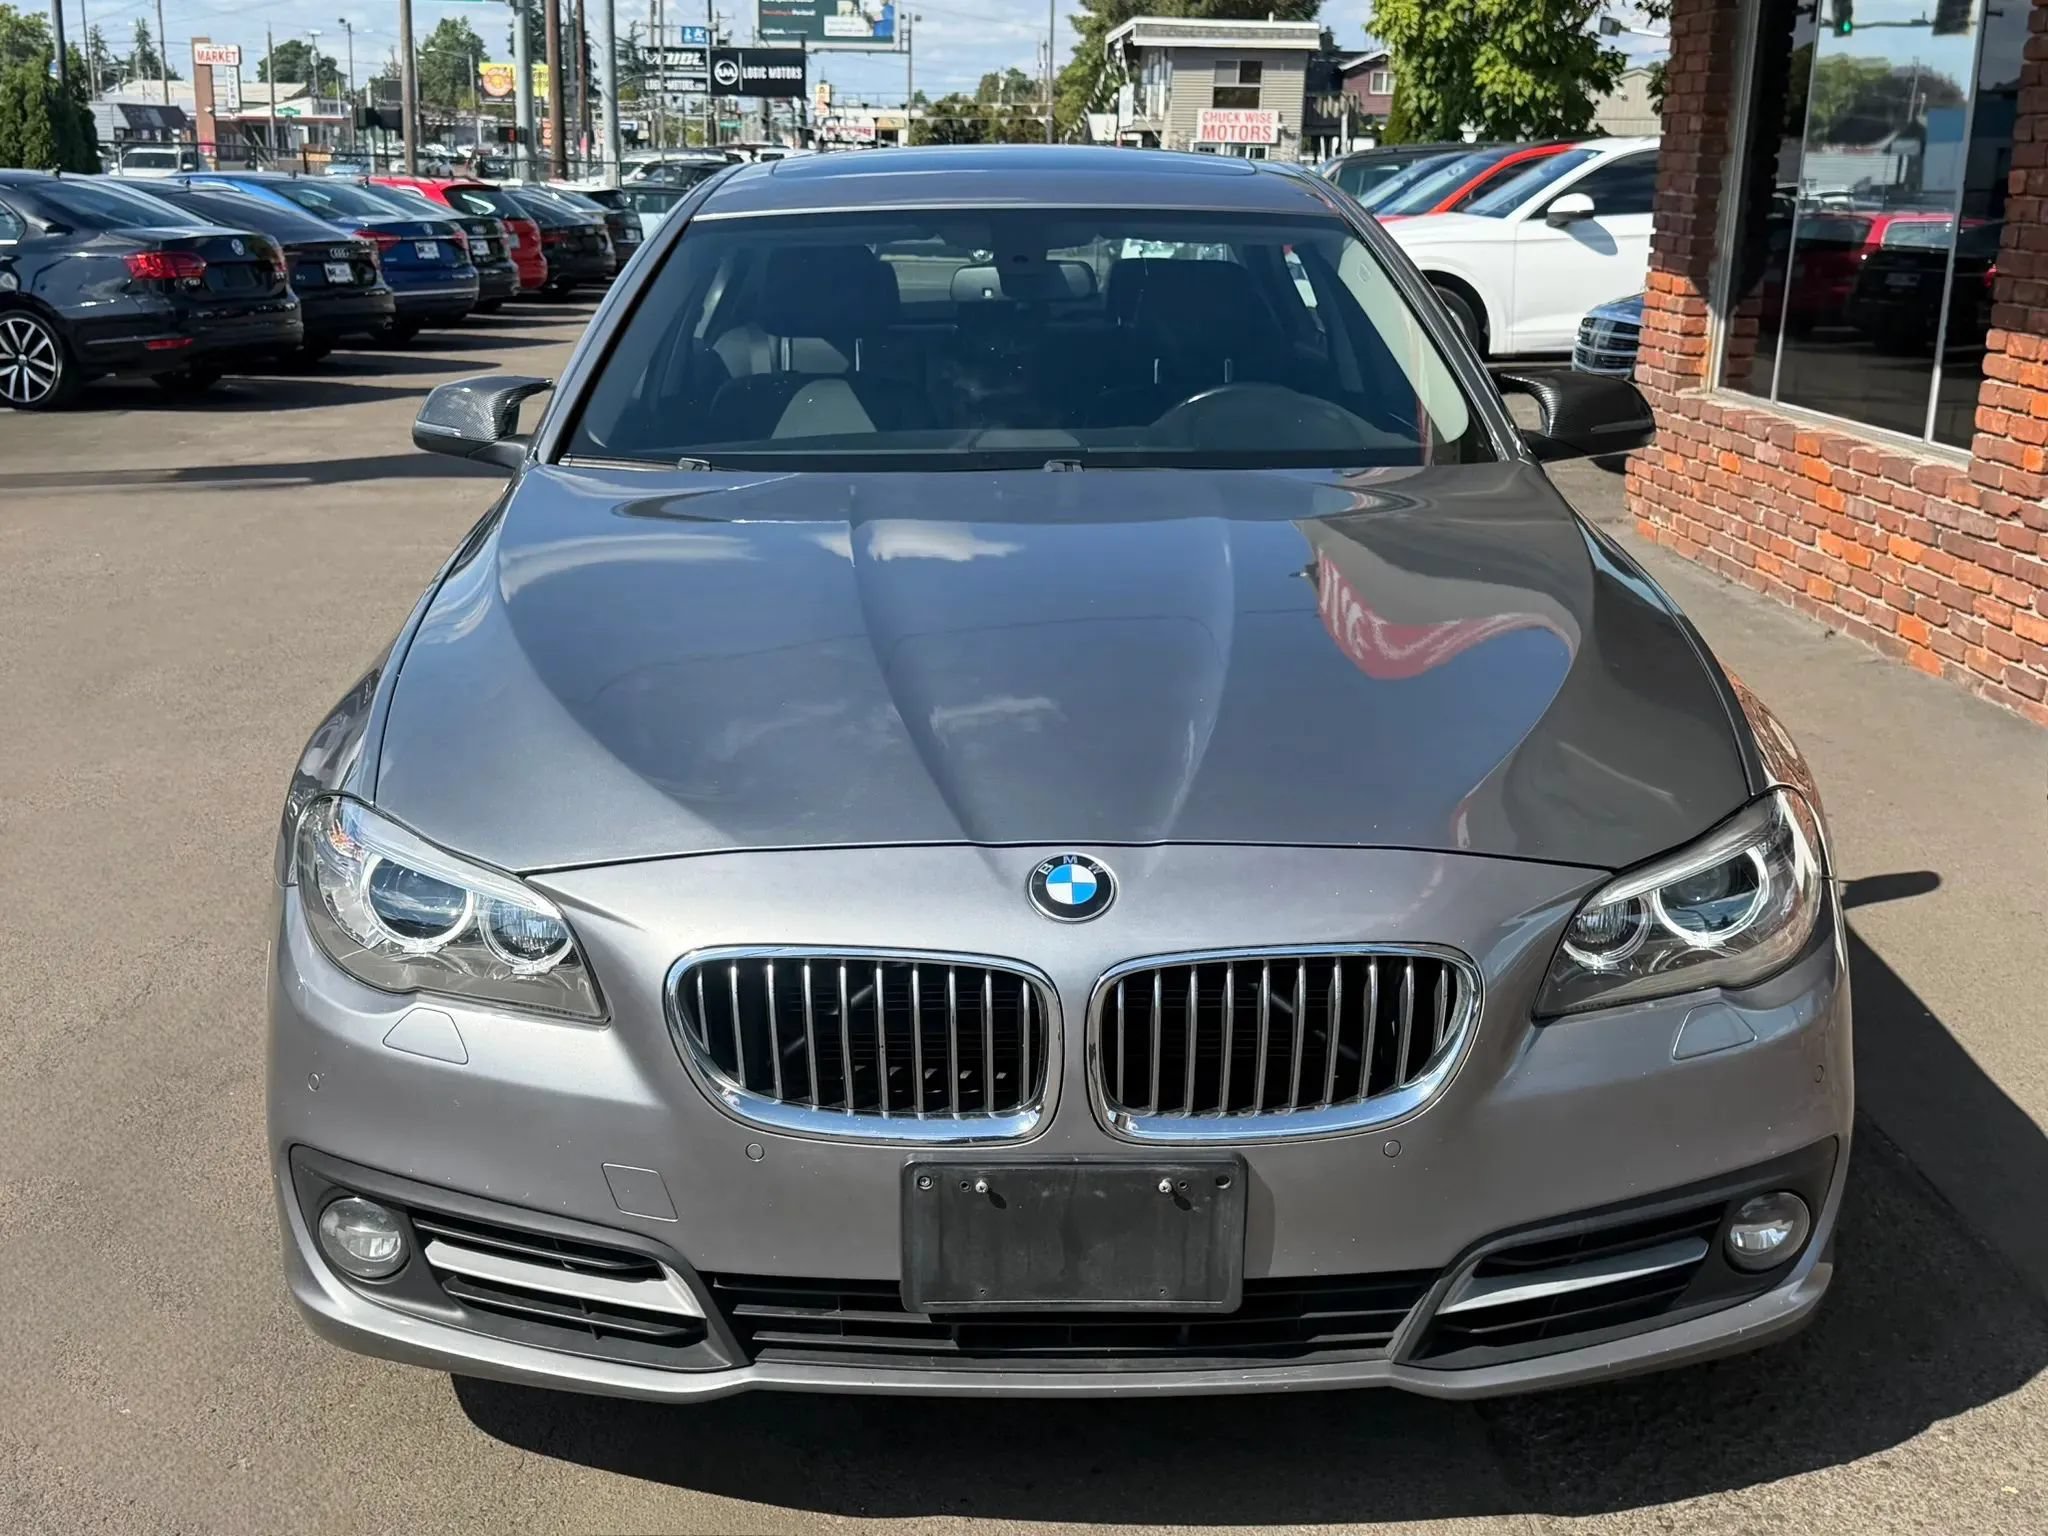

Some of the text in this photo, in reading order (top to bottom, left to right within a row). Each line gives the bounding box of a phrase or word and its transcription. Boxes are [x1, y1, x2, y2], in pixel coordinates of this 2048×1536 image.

[196, 50, 238, 63] MARKET
[742, 66, 803, 79] LOGIC MOTORS
[1202, 111, 1273, 123] CHUCK WISE
[1201, 124, 1272, 141] MOTORS
[1038, 855, 1104, 875] BMW
